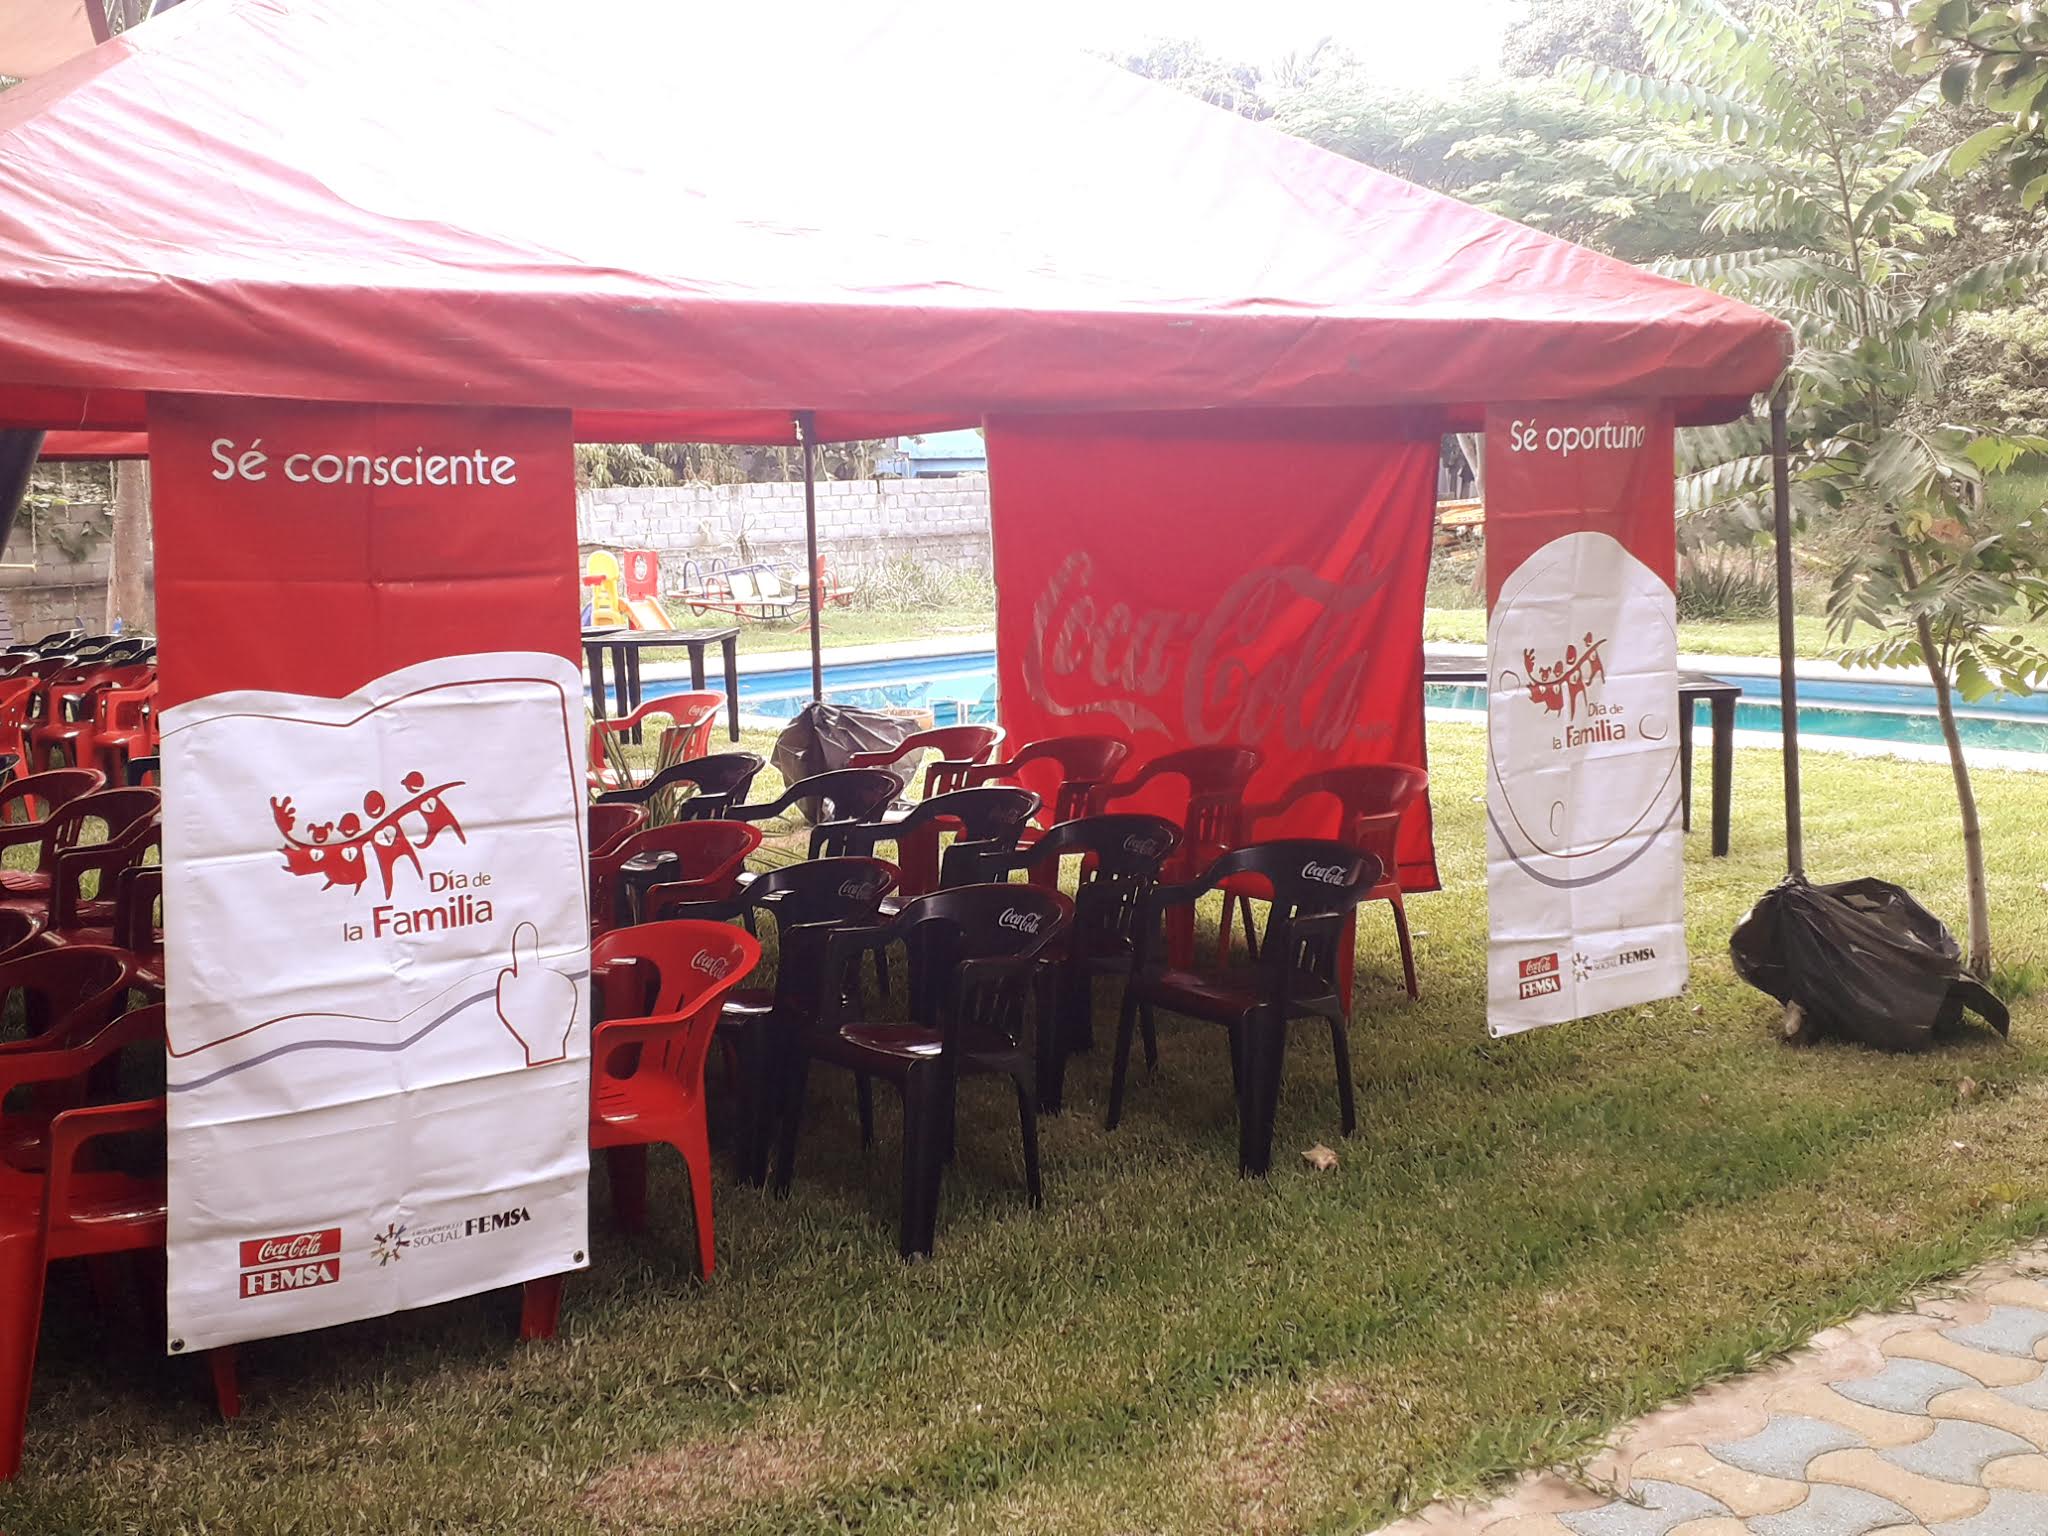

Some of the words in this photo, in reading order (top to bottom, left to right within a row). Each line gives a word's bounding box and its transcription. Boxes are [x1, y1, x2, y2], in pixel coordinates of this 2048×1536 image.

[1510, 418, 1538, 451] Sé
[1546, 421, 1645, 457] oportuno
[211, 438, 268, 481] Sé
[284, 446, 517, 485] consciente
[1588, 702, 1606, 717] Día
[1609, 703, 1624, 714] de
[1552, 736, 1562, 750] la
[1566, 719, 1626, 748] Familia
[429, 870, 467, 893] Día
[472, 872, 492, 888] de
[344, 923, 363, 942] la
[372, 894, 493, 939] Familia
[1619, 948, 1656, 965] FEMSA
[1522, 977, 1558, 999] FEMSA
[413, 1230, 462, 1248] SOCIAL
[465, 1206, 531, 1237] FEMSA
[245, 1263, 334, 1295] FEMSA
